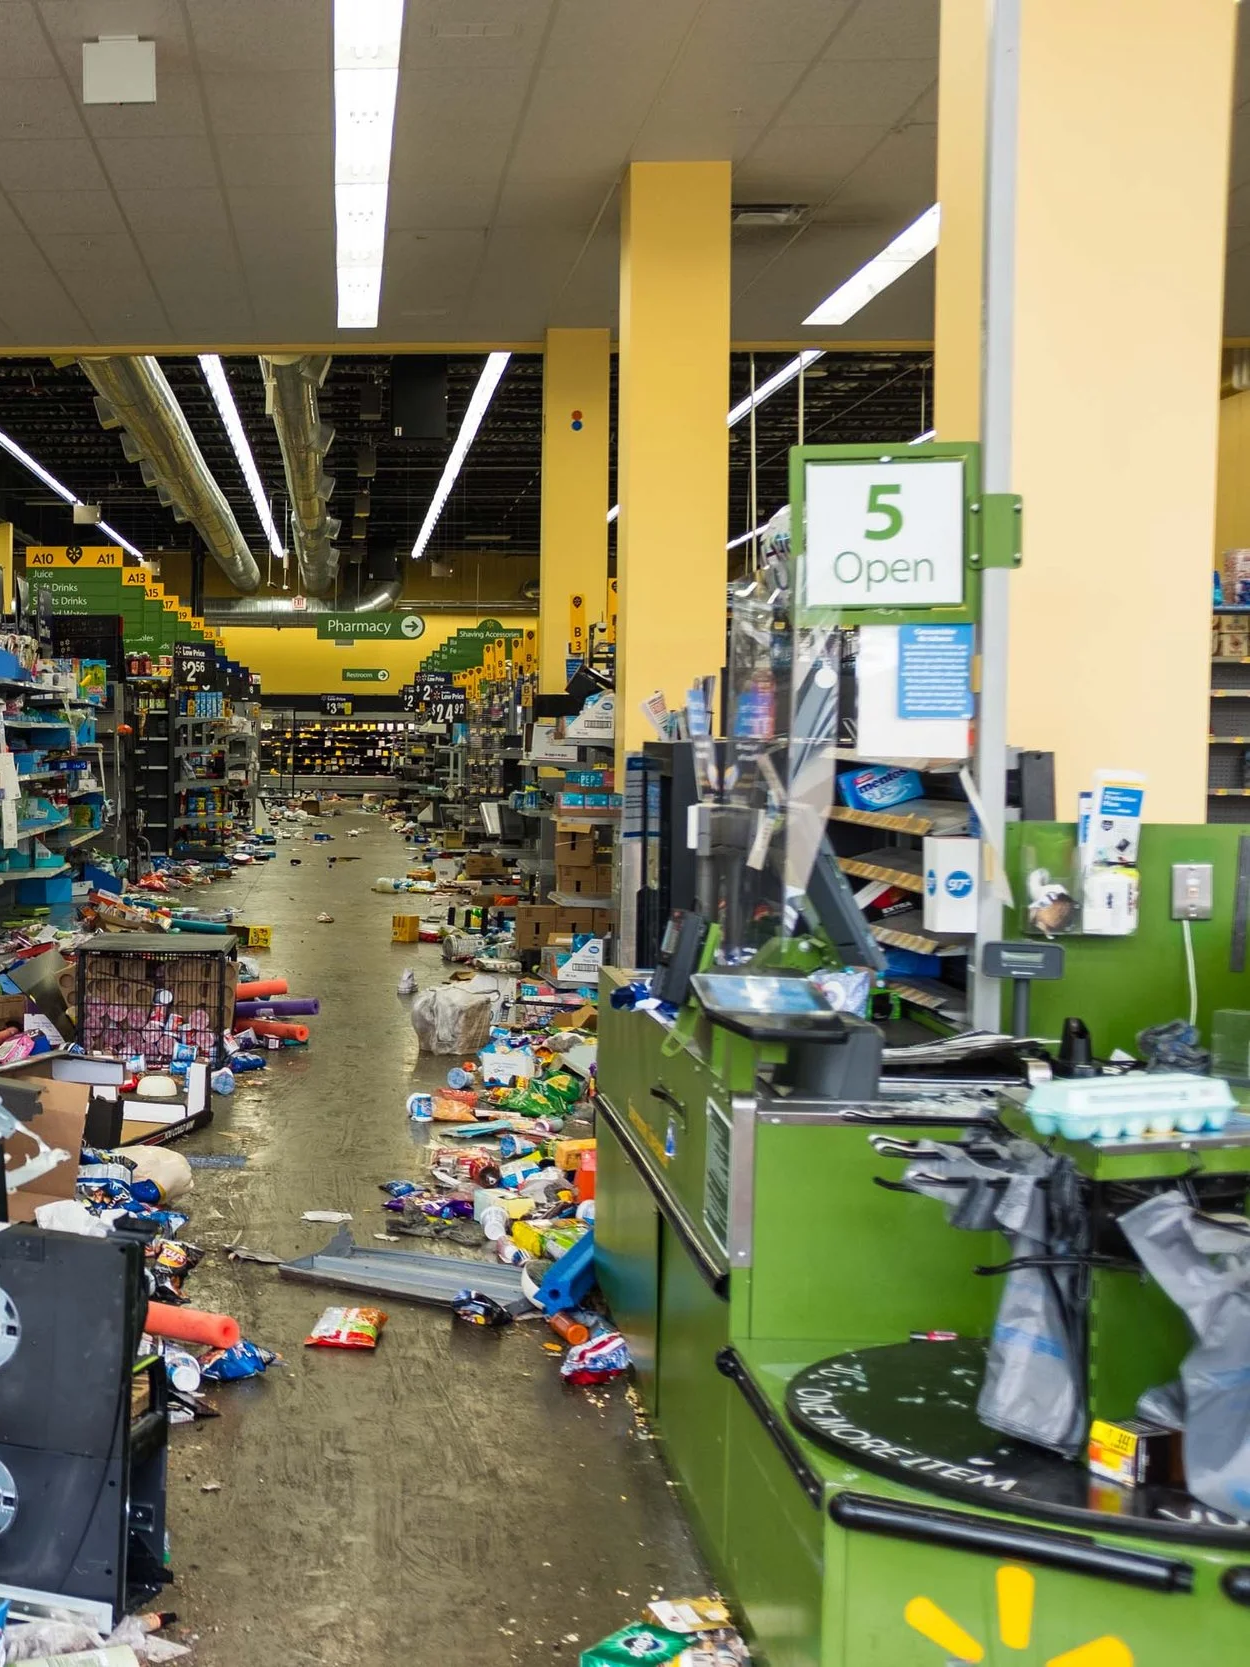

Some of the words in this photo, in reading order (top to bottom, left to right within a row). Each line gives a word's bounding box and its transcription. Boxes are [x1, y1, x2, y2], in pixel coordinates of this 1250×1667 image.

[864, 484, 904, 541] 5
[32, 553, 54, 565] A10
[96, 553, 115, 565] A11
[32, 570, 54, 579] Juice
[833, 551, 935, 592] Open
[127, 573, 146, 583] A13
[33, 583, 51, 592] Sft
[52, 583, 78, 592] Drinks
[33, 596, 59, 606] Sts
[61, 596, 88, 606] Drinks
[327, 619, 392, 635] Pharmacy
[574, 627, 582, 637] B
[459, 631, 484, 639] Shaving
[485, 631, 521, 639] Accessories
[576, 641, 582, 651] 3
[182, 649, 192, 657] Low
[192, 649, 206, 658] Price
[526, 654, 532, 663] B
[795, 1388, 840, 1416] ONE
[809, 1416, 916, 1458] MORE
[899, 1457, 1018, 1492] ITEM
